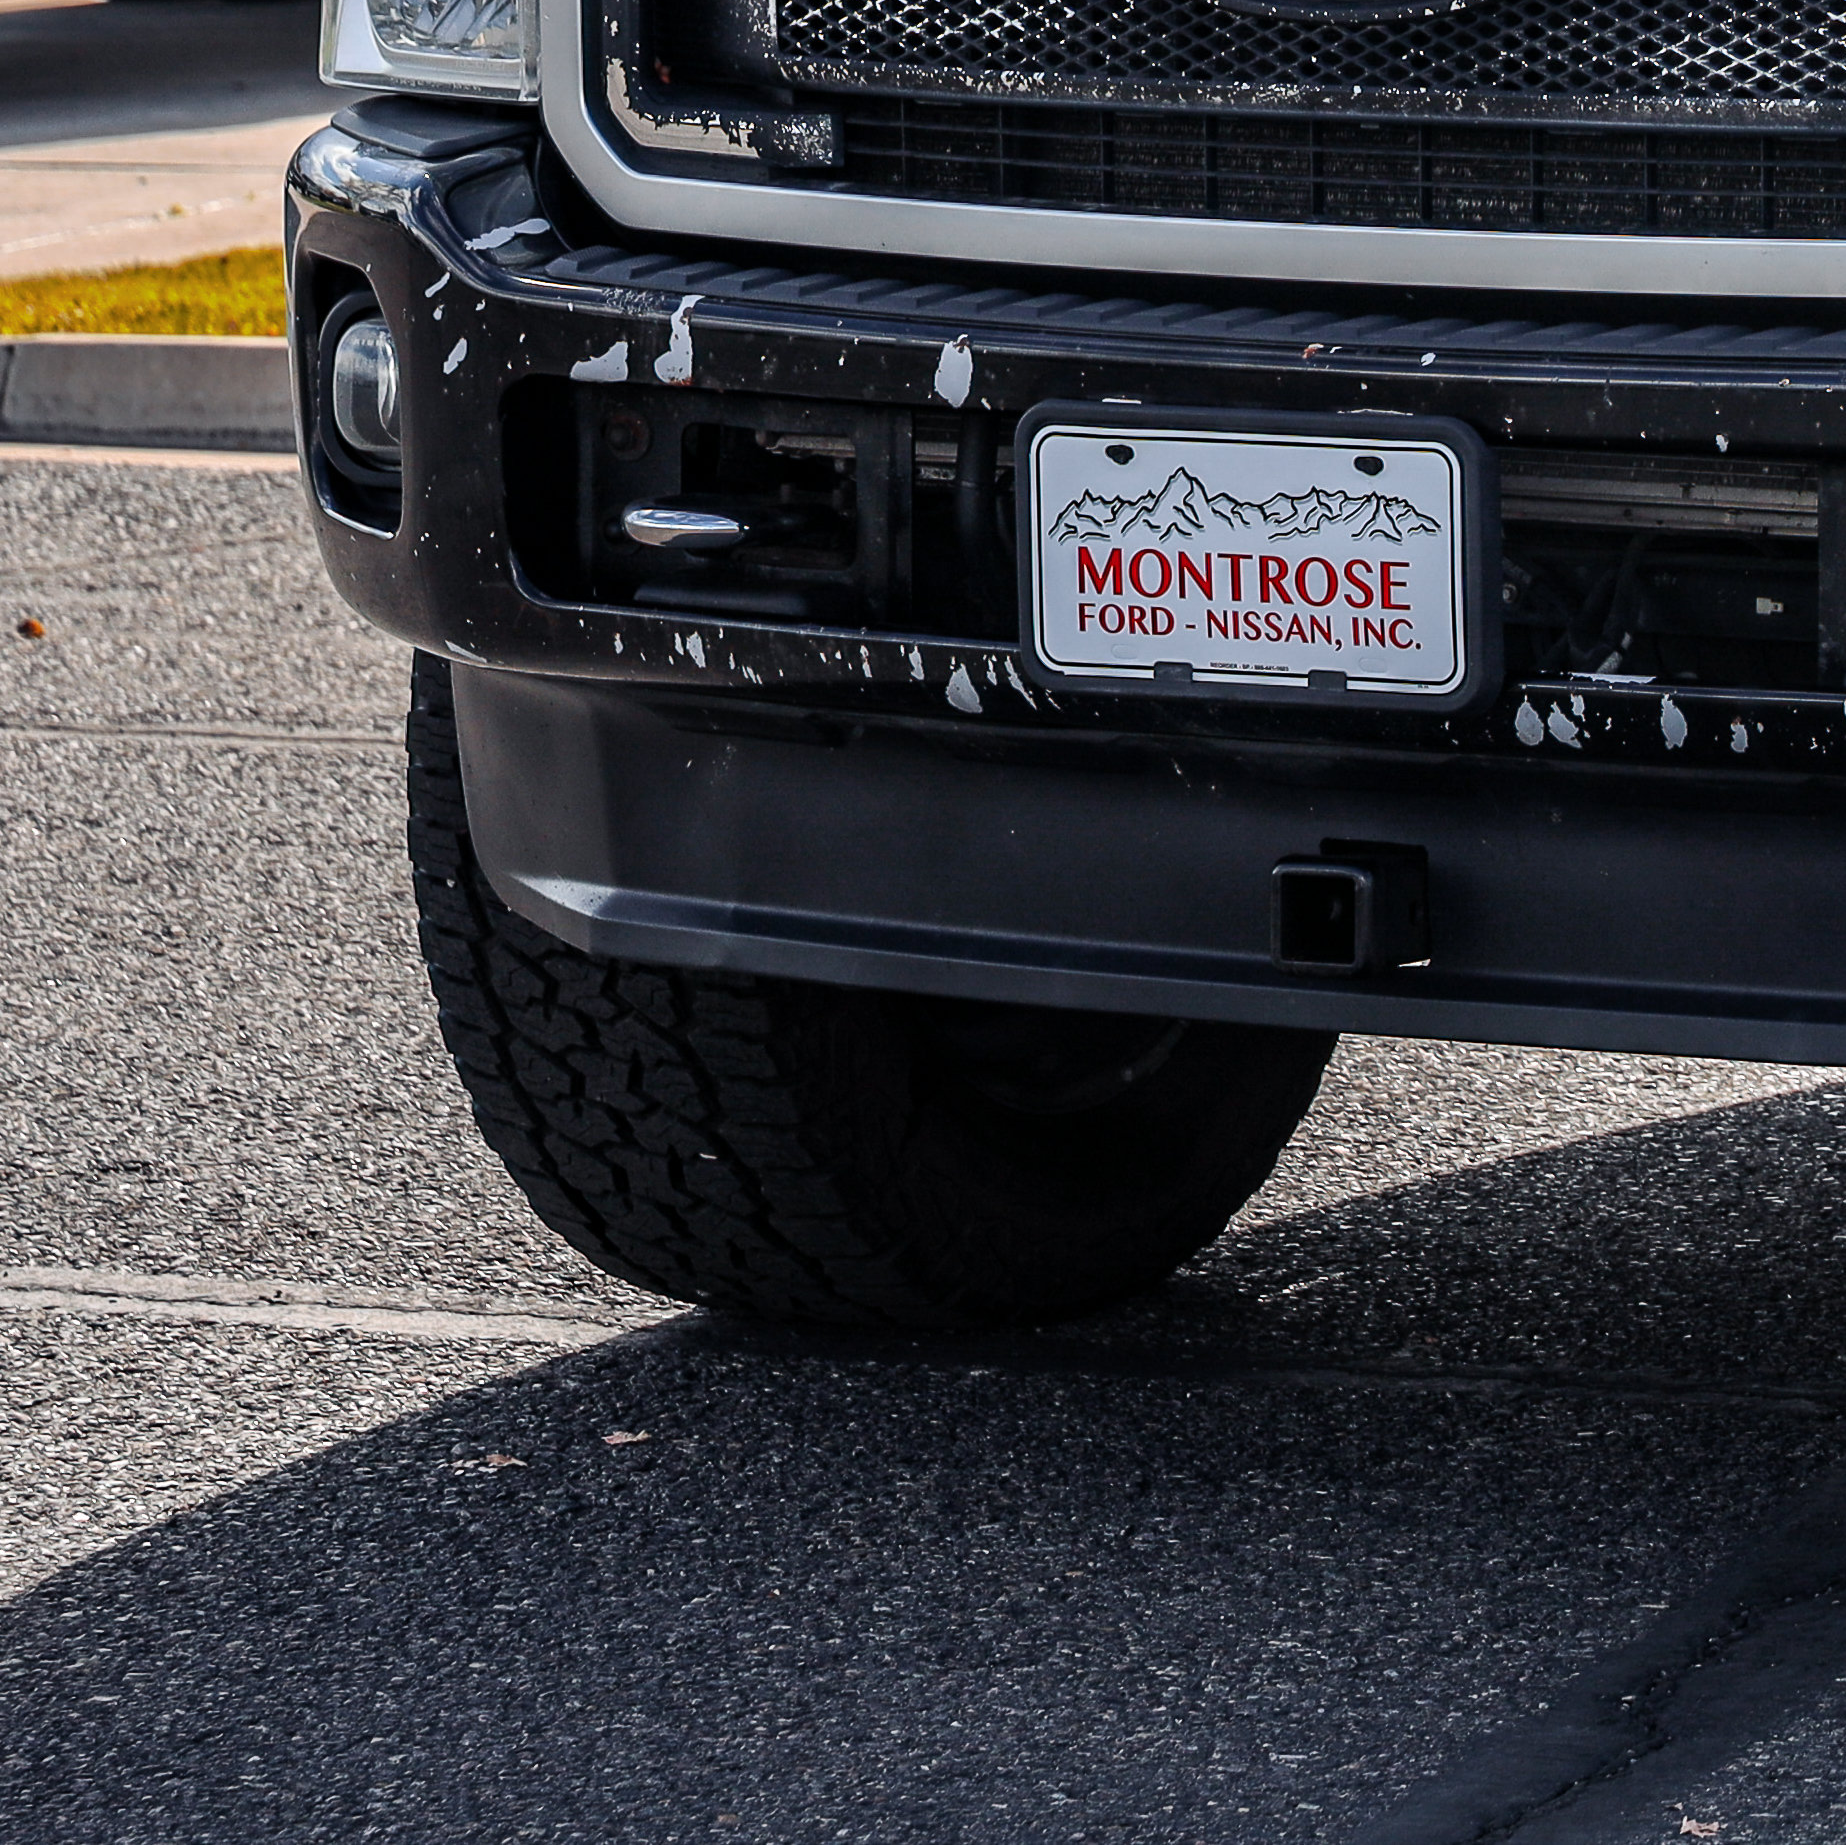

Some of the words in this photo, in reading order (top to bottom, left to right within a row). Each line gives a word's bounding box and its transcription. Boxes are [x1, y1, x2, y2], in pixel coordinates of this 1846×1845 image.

[1077, 545, 1412, 611] MONTROSE
[1078, 602, 1175, 637] FORD
[1206, 608, 1343, 652] NISSAN,
[1352, 616, 1422, 651] INC.
